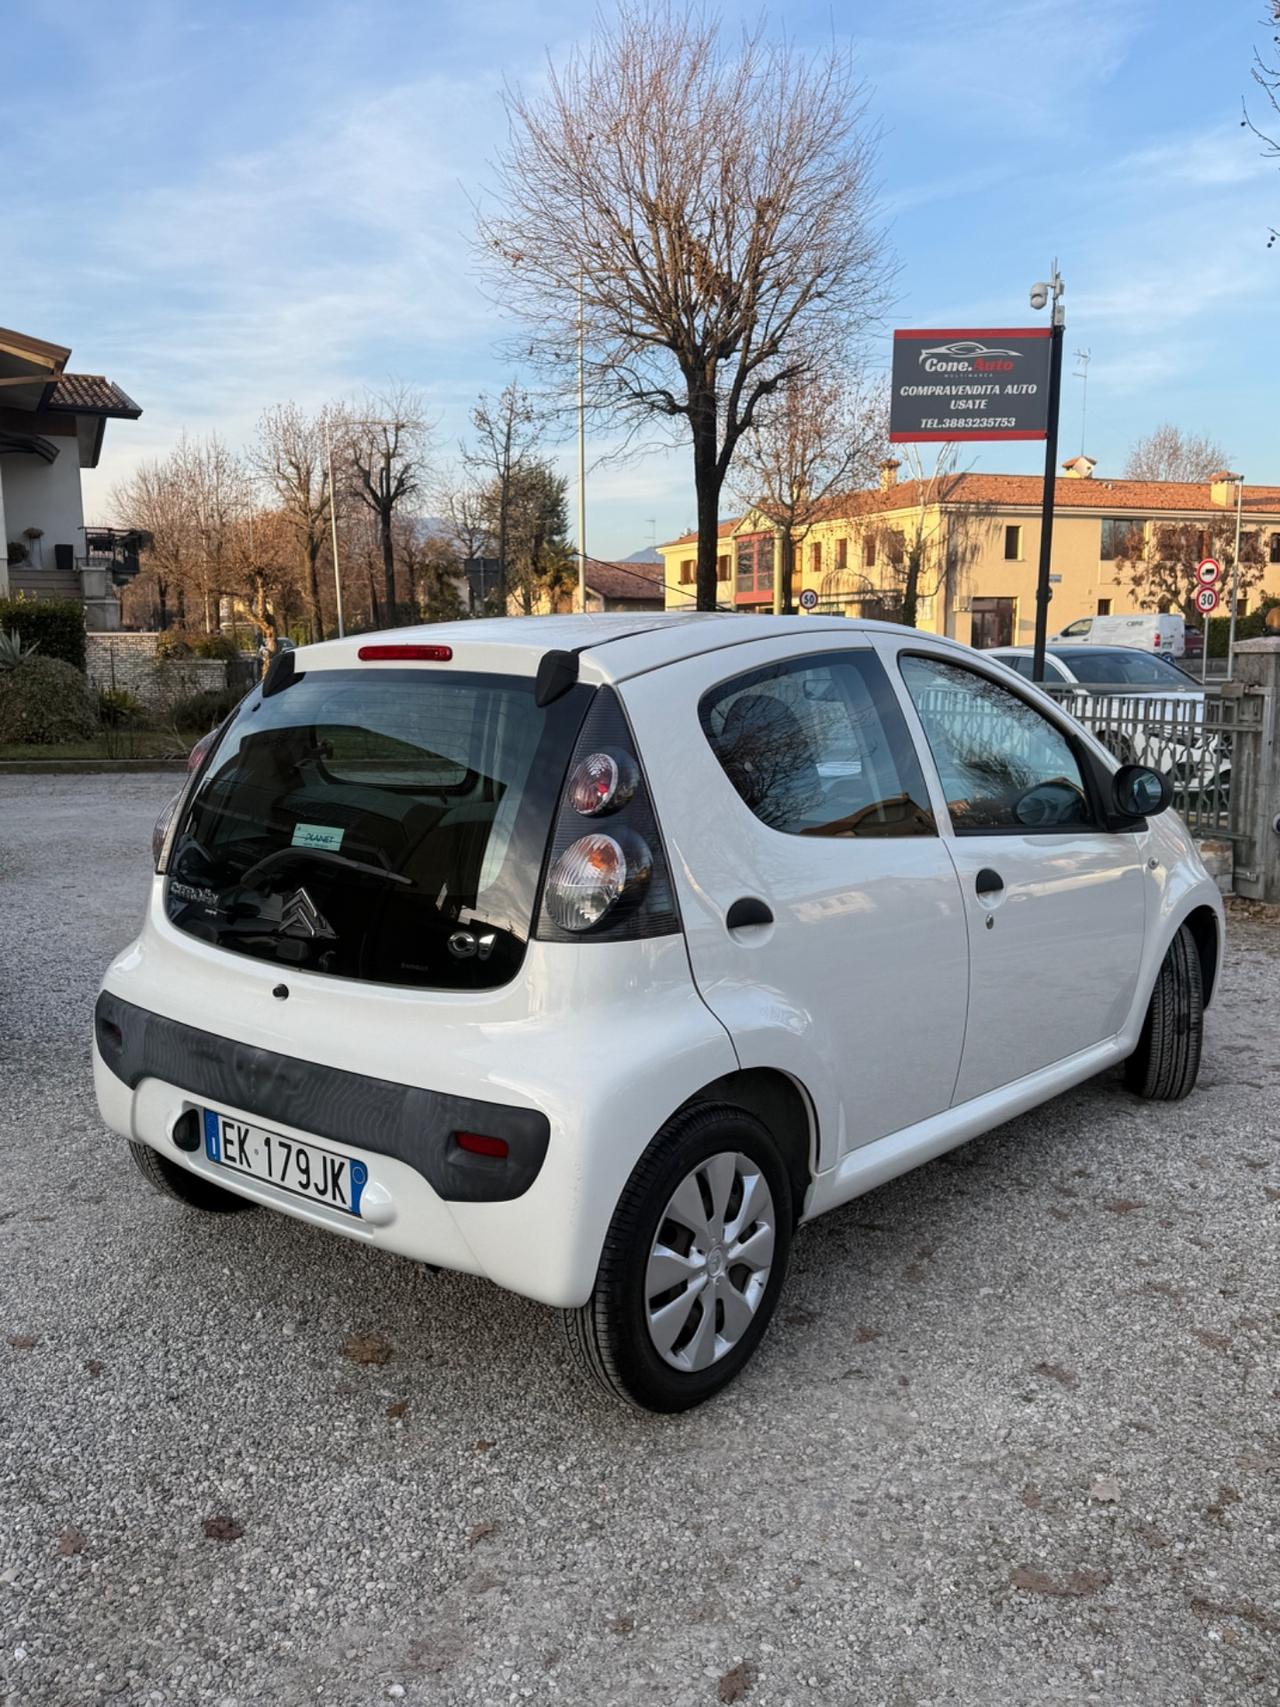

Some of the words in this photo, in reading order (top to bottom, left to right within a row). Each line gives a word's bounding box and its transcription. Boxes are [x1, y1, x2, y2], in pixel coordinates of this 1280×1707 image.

[900, 384, 1000, 396] COMPRAVENDITA
[1003, 383, 1037, 395] AUTO
[950, 399, 988, 410] USATE
[804, 594, 815, 605] 50
[1200, 593, 1214, 606] 30
